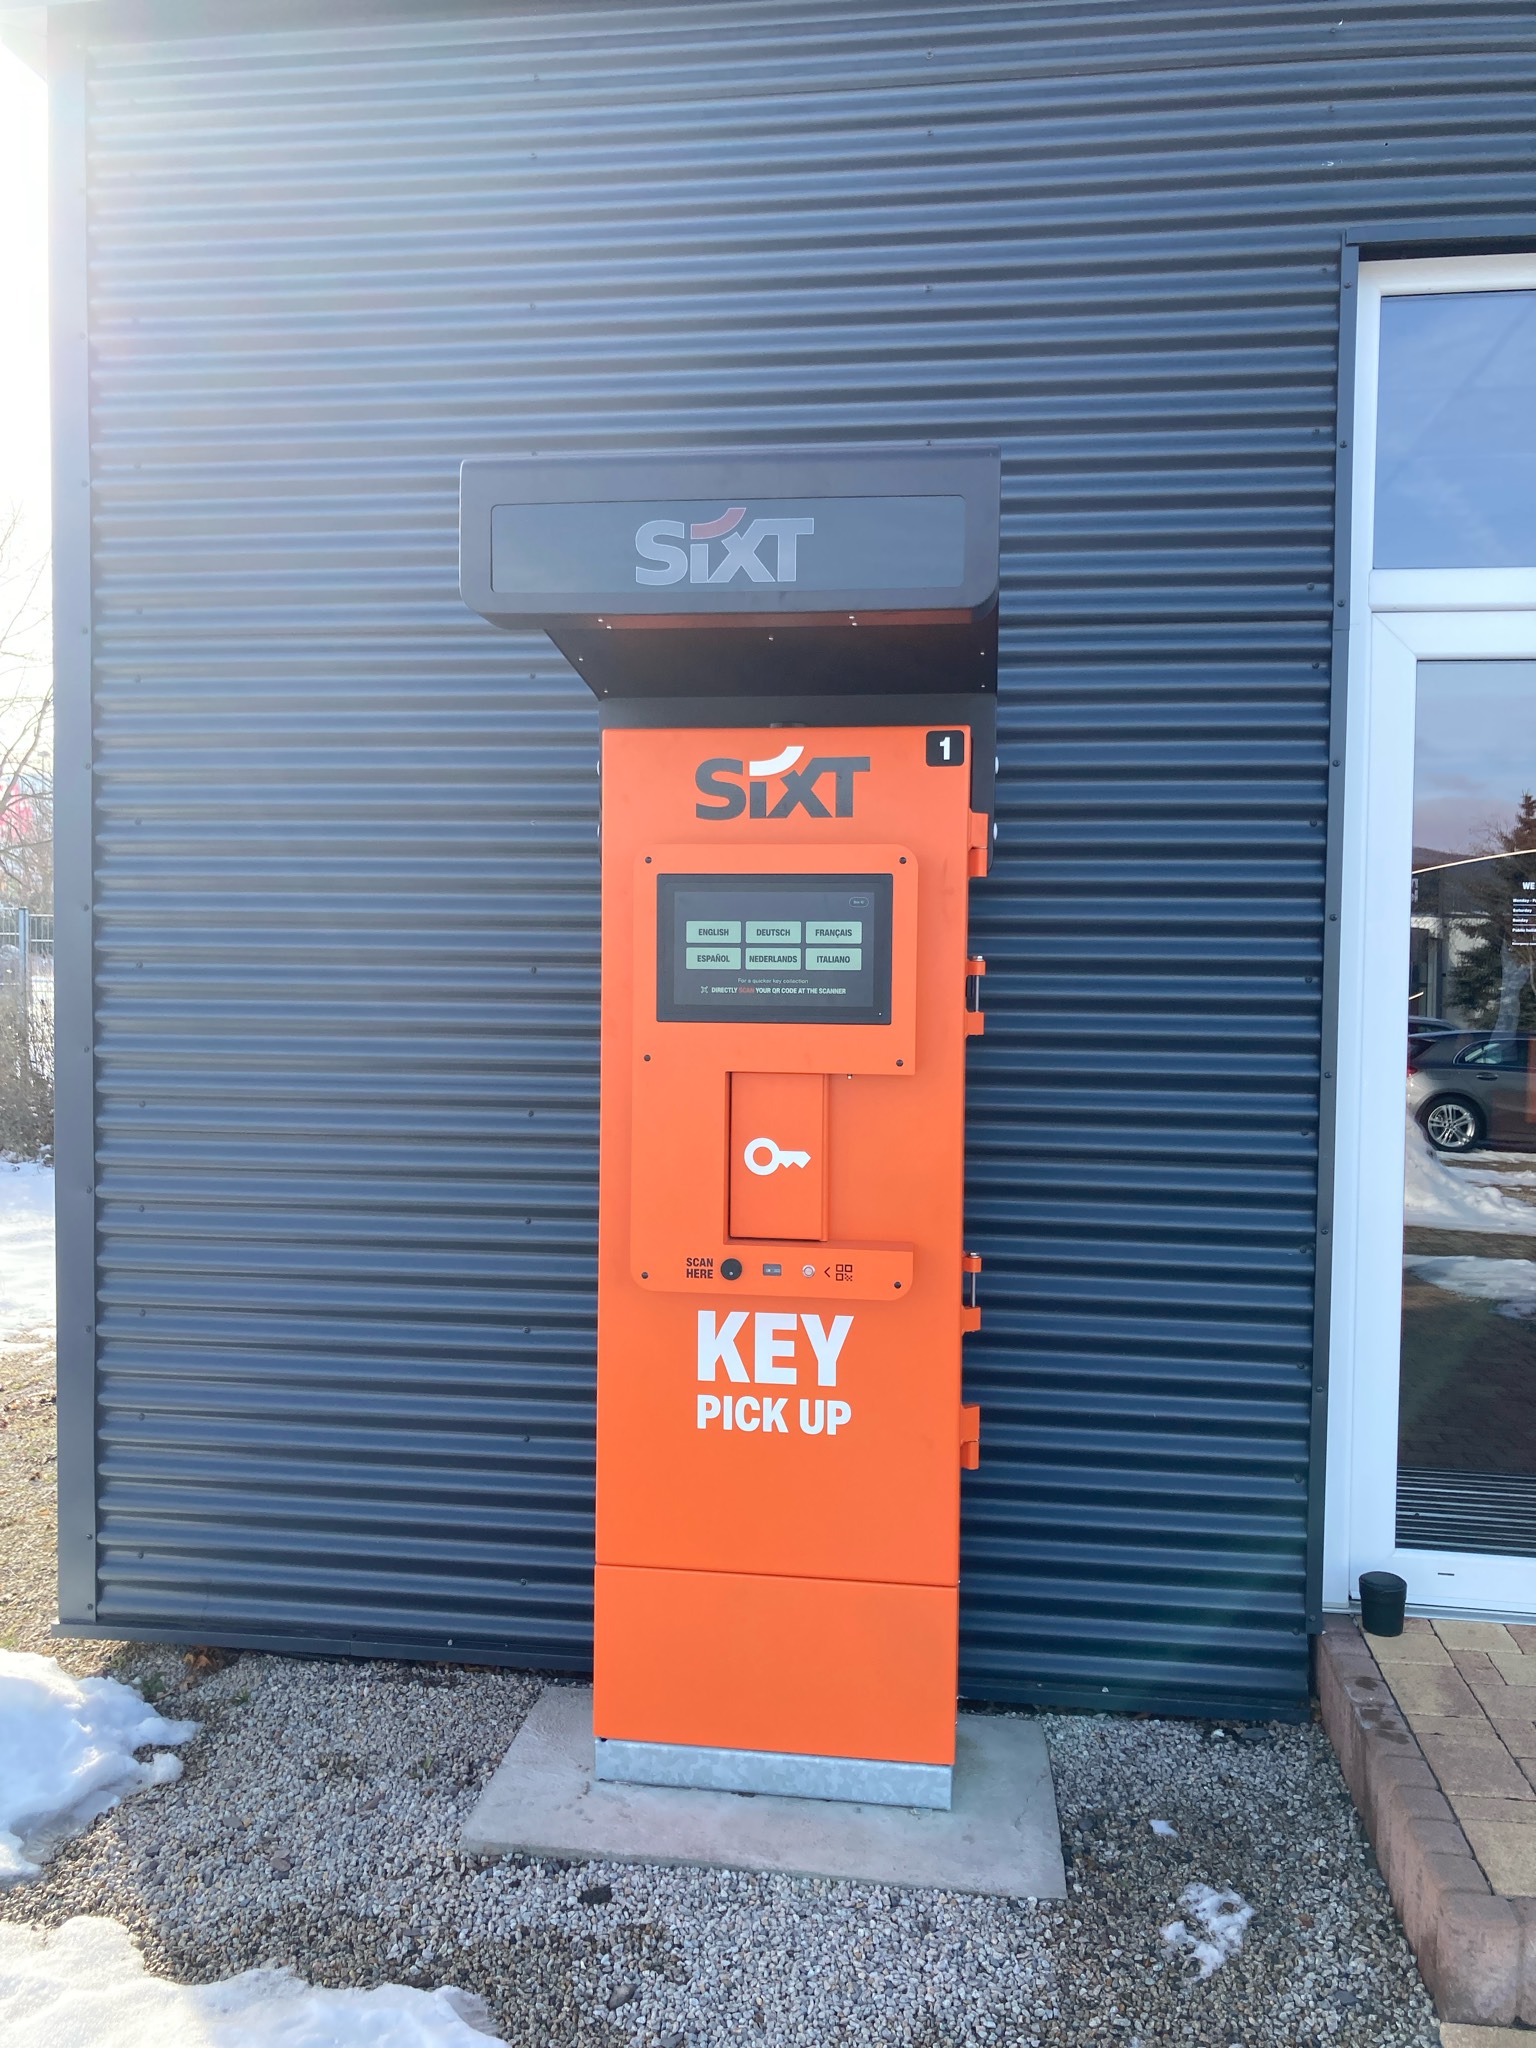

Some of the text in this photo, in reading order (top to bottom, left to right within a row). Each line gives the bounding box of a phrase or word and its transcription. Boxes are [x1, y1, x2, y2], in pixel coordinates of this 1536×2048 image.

[939, 736, 951, 760] 1
[1522, 881, 1536, 890] WE
[698, 928, 729, 936] ENGLISH
[756, 928, 791, 937] DEUTSCH
[815, 928, 853, 938] FRANÇAIS
[697, 953, 730, 963] ESPAÑOL
[749, 955, 798, 963] NEDERLANDS
[816, 955, 851, 964] ITALIANO
[711, 986, 738, 994] DIRECTLY
[738, 986, 755, 994] SCAN
[818, 987, 847, 995] SCANNER
[686, 1257, 714, 1268] SCAN
[686, 1268, 714, 1279] HERE
[697, 1310, 855, 1387] KEY
[697, 1394, 852, 1436] PICK UP
